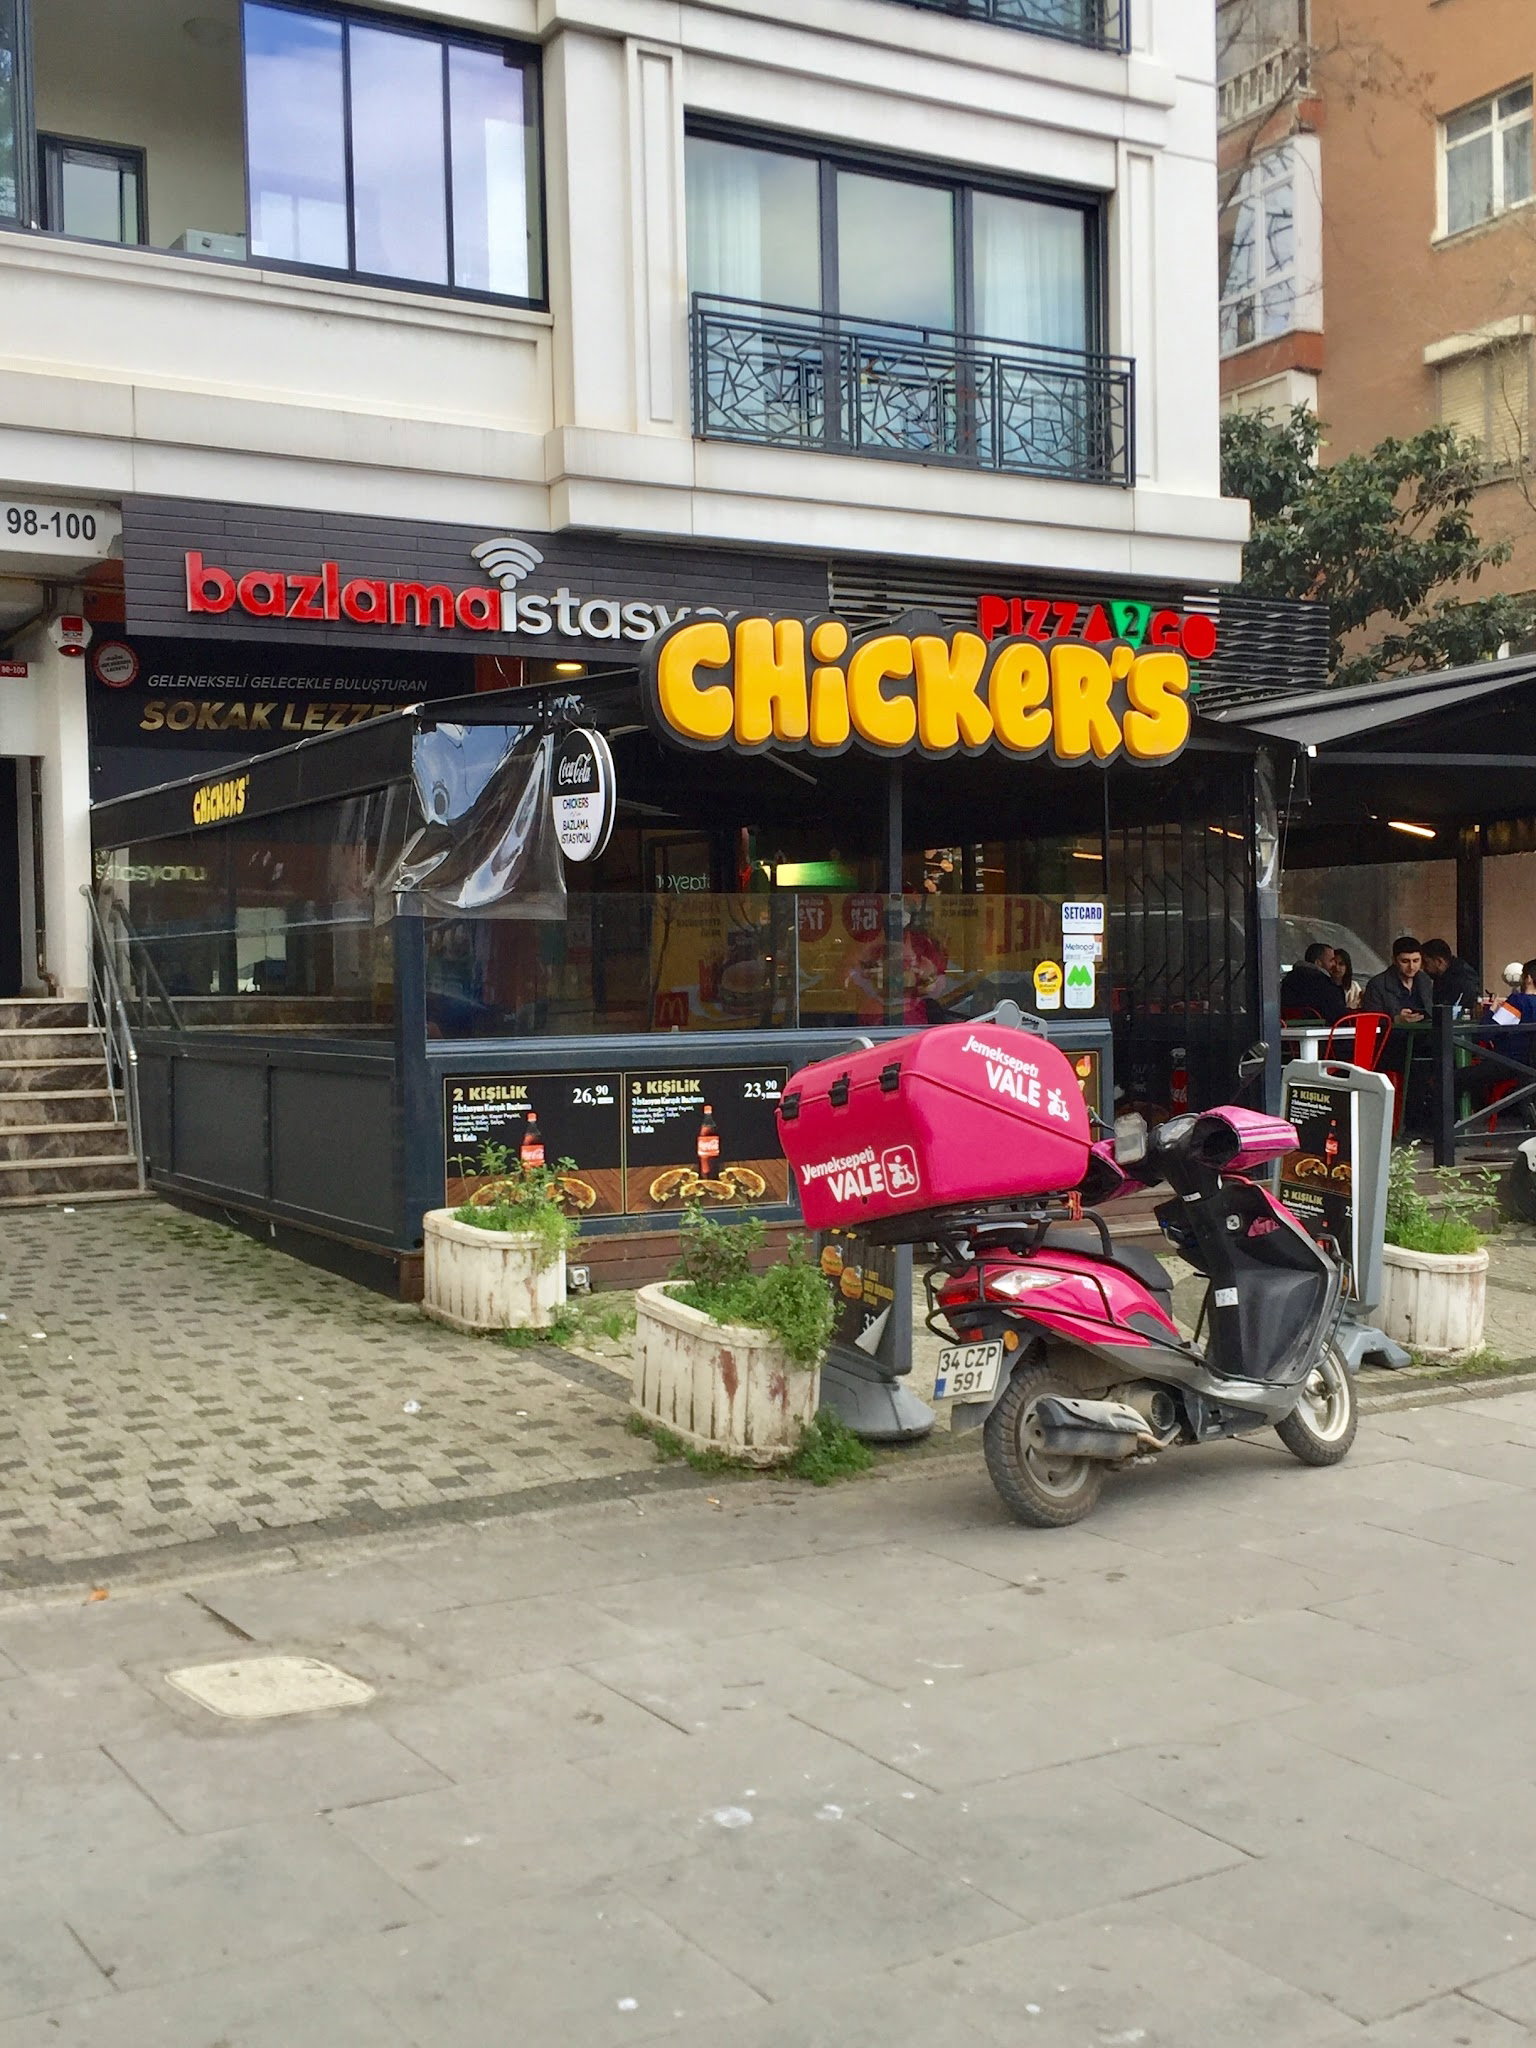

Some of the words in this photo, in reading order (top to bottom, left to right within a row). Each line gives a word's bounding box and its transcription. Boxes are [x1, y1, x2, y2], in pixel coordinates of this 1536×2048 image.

[6, 507, 97, 541] 98-100
[184, 550, 500, 633] bazlama
[147, 673, 248, 688] GELENEKSELİ
[250, 676, 331, 690] GELECEKLE
[334, 678, 427, 694] BULUŞTURAN
[139, 702, 279, 731] SOKAK
[1064, 906, 1102, 920] SETCARD
[453, 1087, 463, 1102] 2
[631, 1081, 642, 1095] 3
[985, 1060, 1041, 1108] VALE
[1292, 1089, 1299, 1099] 2
[826, 1162, 885, 1203] VALE
[1282, 1189, 1290, 1198] 3
[940, 1351, 960, 1373] 34
[964, 1345, 998, 1369] CZP
[952, 1370, 983, 1393] 591
